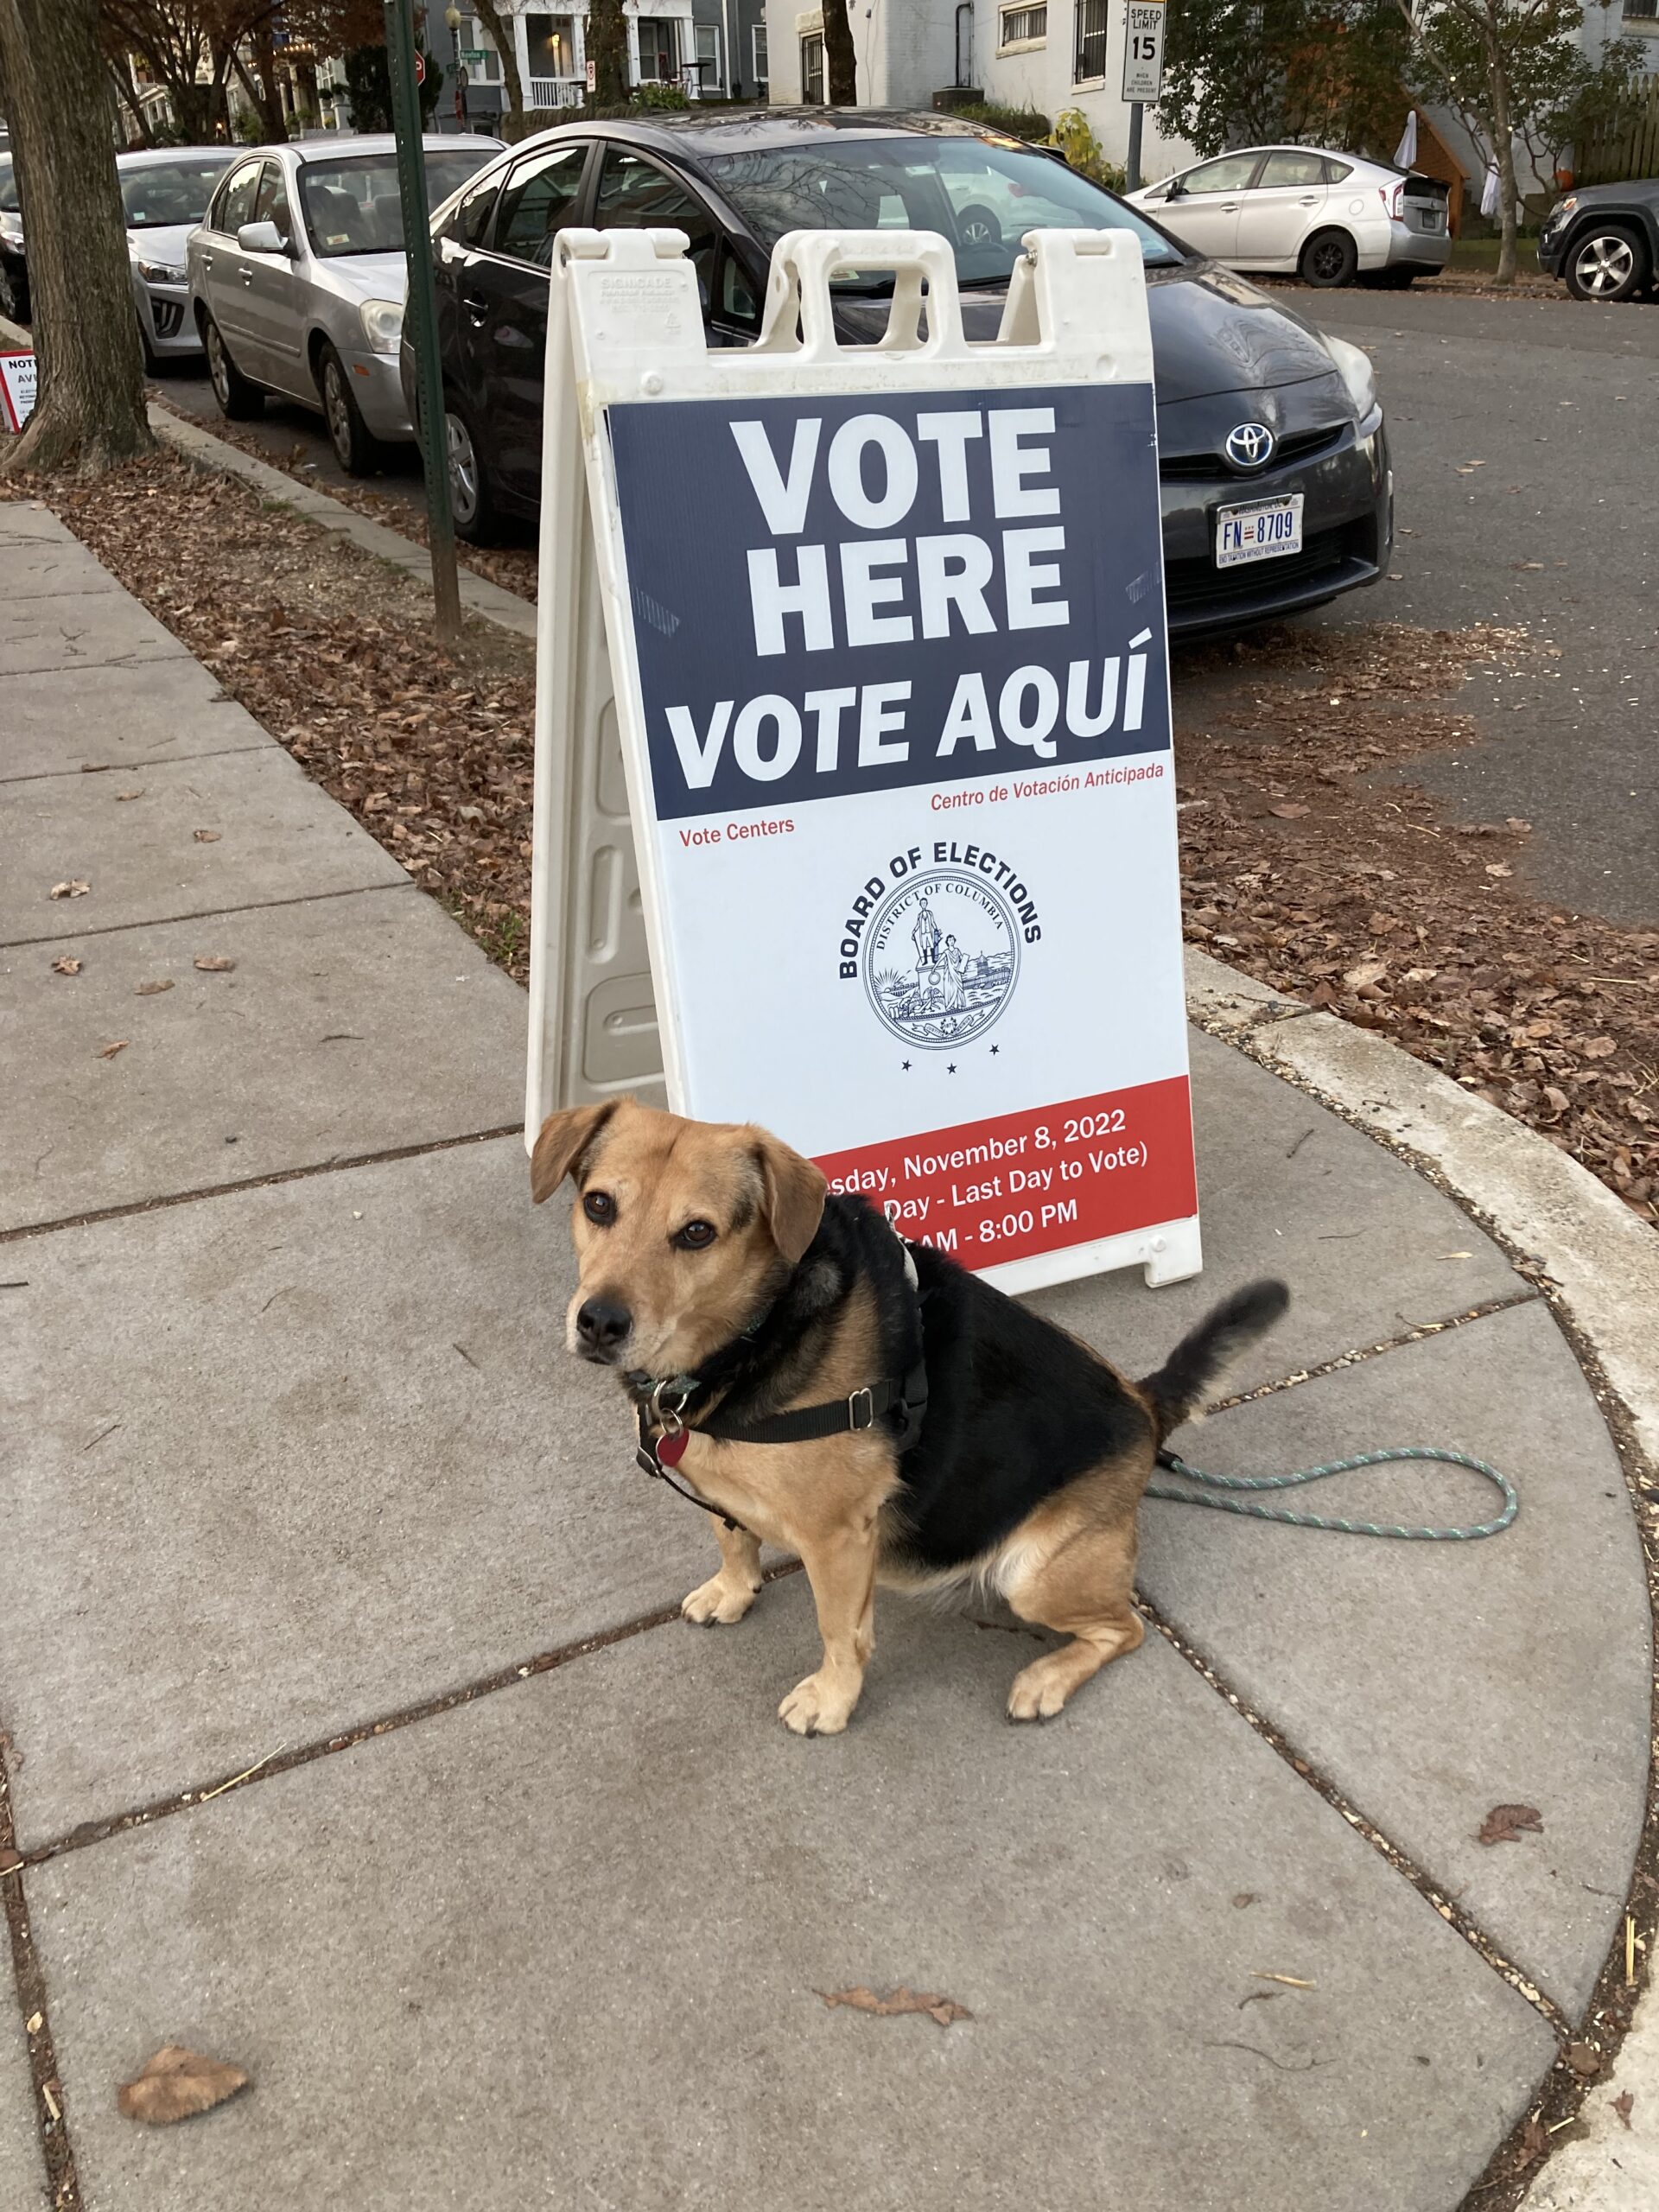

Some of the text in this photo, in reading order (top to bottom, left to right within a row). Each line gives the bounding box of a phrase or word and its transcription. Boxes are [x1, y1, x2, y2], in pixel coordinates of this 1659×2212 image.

[1131, 9, 1162, 20] SPEED
[1133, 19, 1158, 29] LIMIT
[1133, 36, 1155, 60] 15
[729, 407, 1061, 535] VOTE
[1224, 512, 1293, 550] FN 8709
[747, 526, 1070, 657] HERE
[665, 627, 1153, 789] VOTE AQUÍ
[931, 763, 1164, 810] Centro de Votación Anticipada
[679, 819, 795, 847] Vote Centers
[839, 842, 1041, 980] BOARD OF ELECTIONS
[876, 882, 1004, 950] DISTRICT OF COLUMBIA
[827, 1109, 1126, 1196] sday, November 8, 2022
[951, 1175, 1002, 1207] Last
[1009, 1166, 1054, 1193] Day
[1061, 1158, 1084, 1180] to
[1088, 1141, 1147, 1174] Vote)
[979, 1210, 1033, 1243] 8:00
[1041, 1198, 1078, 1228] PM
